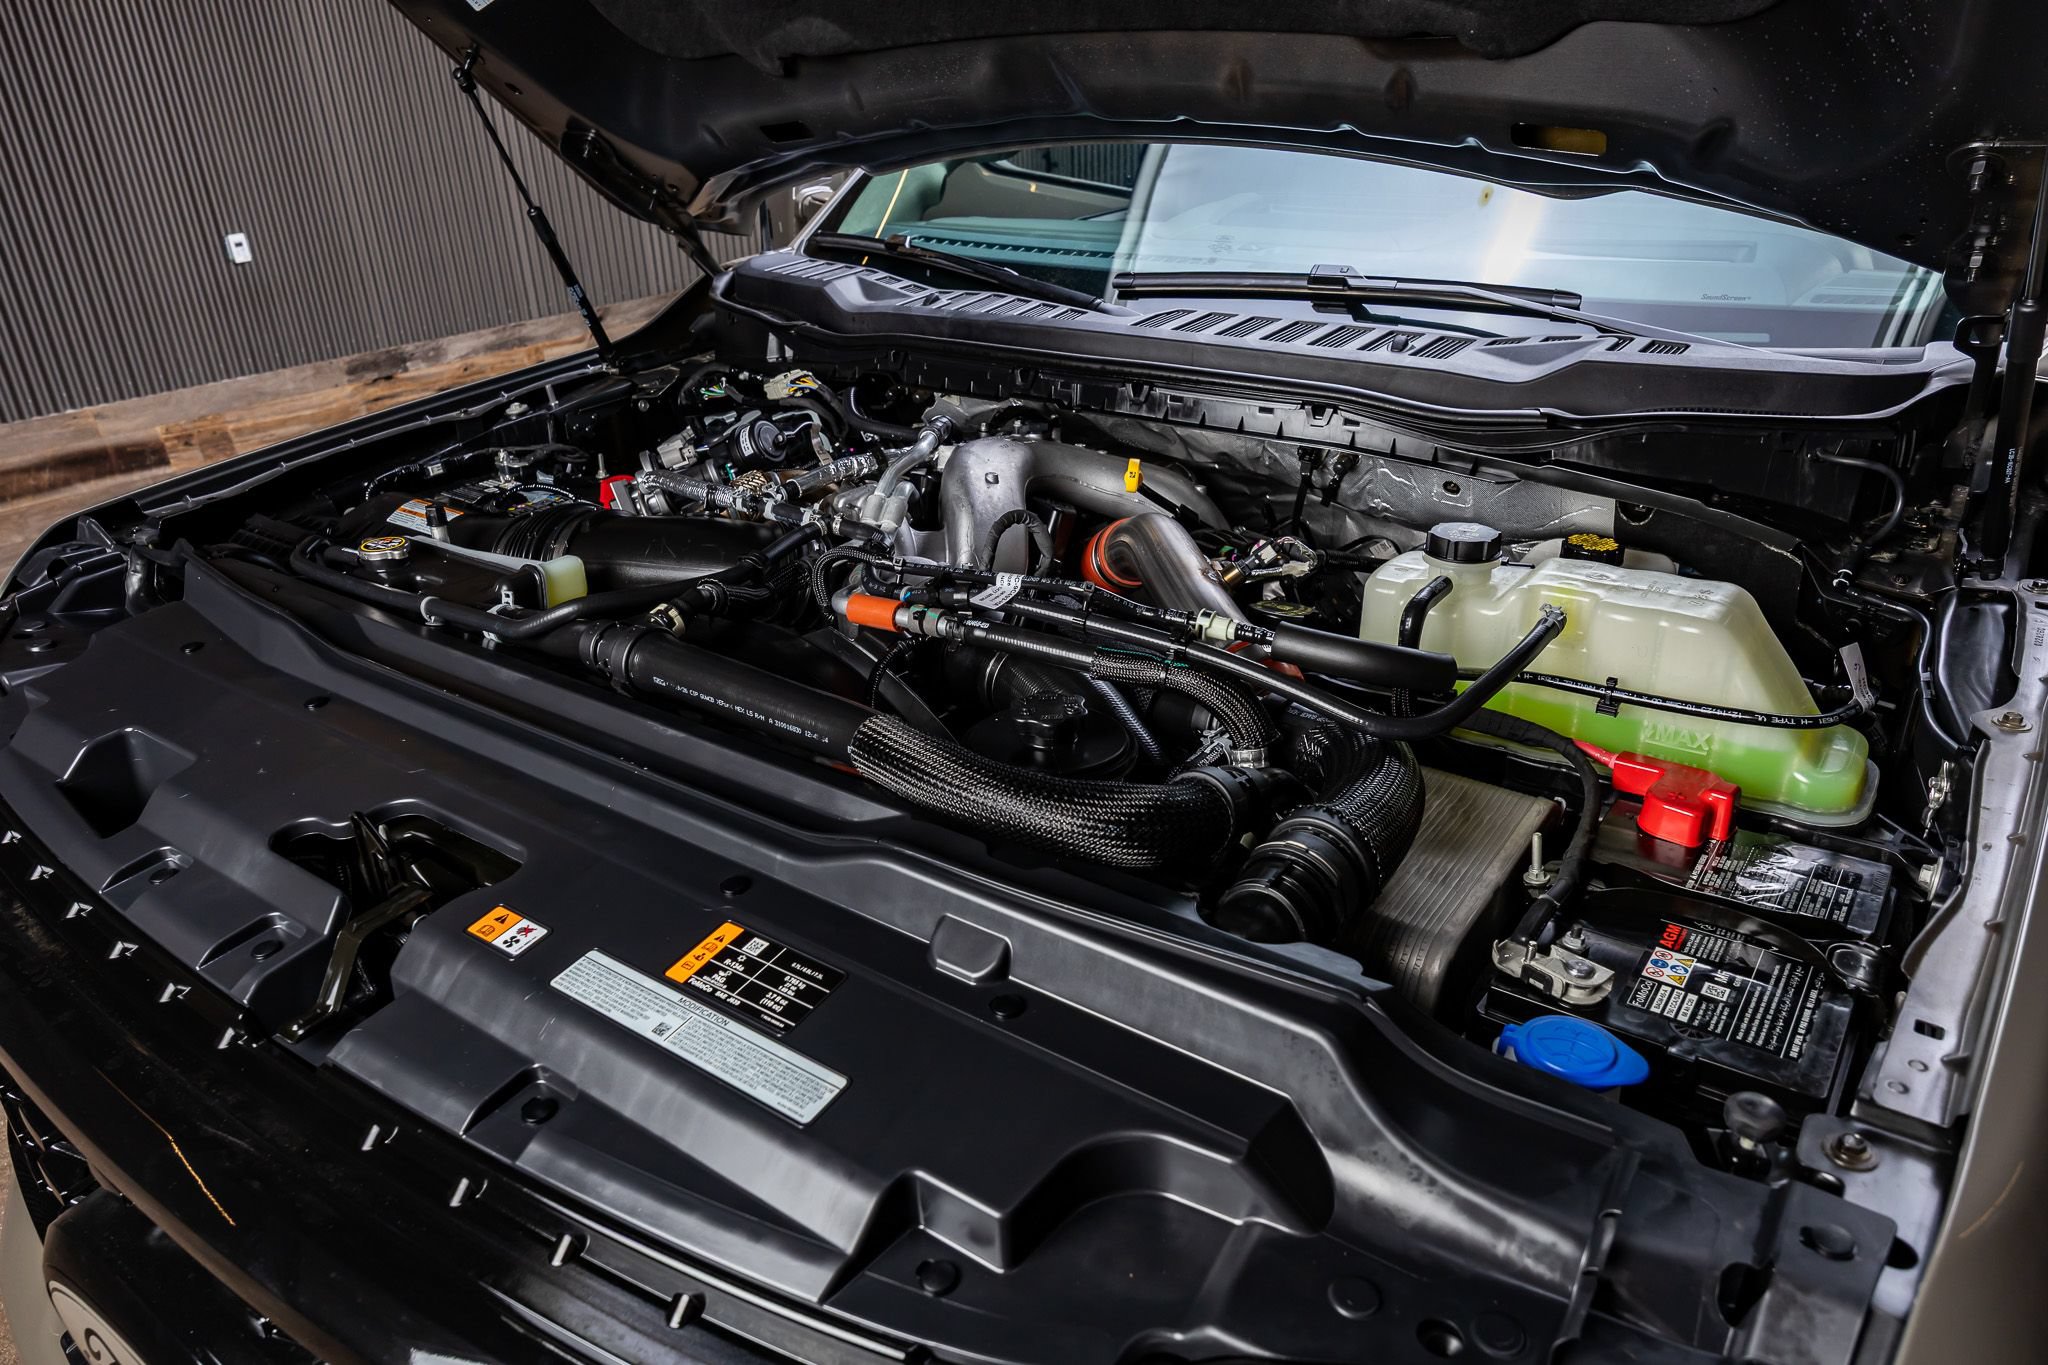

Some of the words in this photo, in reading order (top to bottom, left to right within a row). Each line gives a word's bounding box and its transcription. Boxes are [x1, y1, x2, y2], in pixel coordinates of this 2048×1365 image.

[1771, 716, 1796, 724] TYPE
[1658, 922, 1681, 949] AGM
[722, 958, 746, 971] R-134a
[710, 973, 727, 983] PAG
[686, 977, 714, 993] FoMoCo
[713, 990, 728, 999] SAE
[1632, 978, 1653, 1007] FoMoCo
[764, 991, 777, 1000] 3.7
[778, 998, 789, 1006] oz
[676, 996, 730, 1026] MODIFICATION
